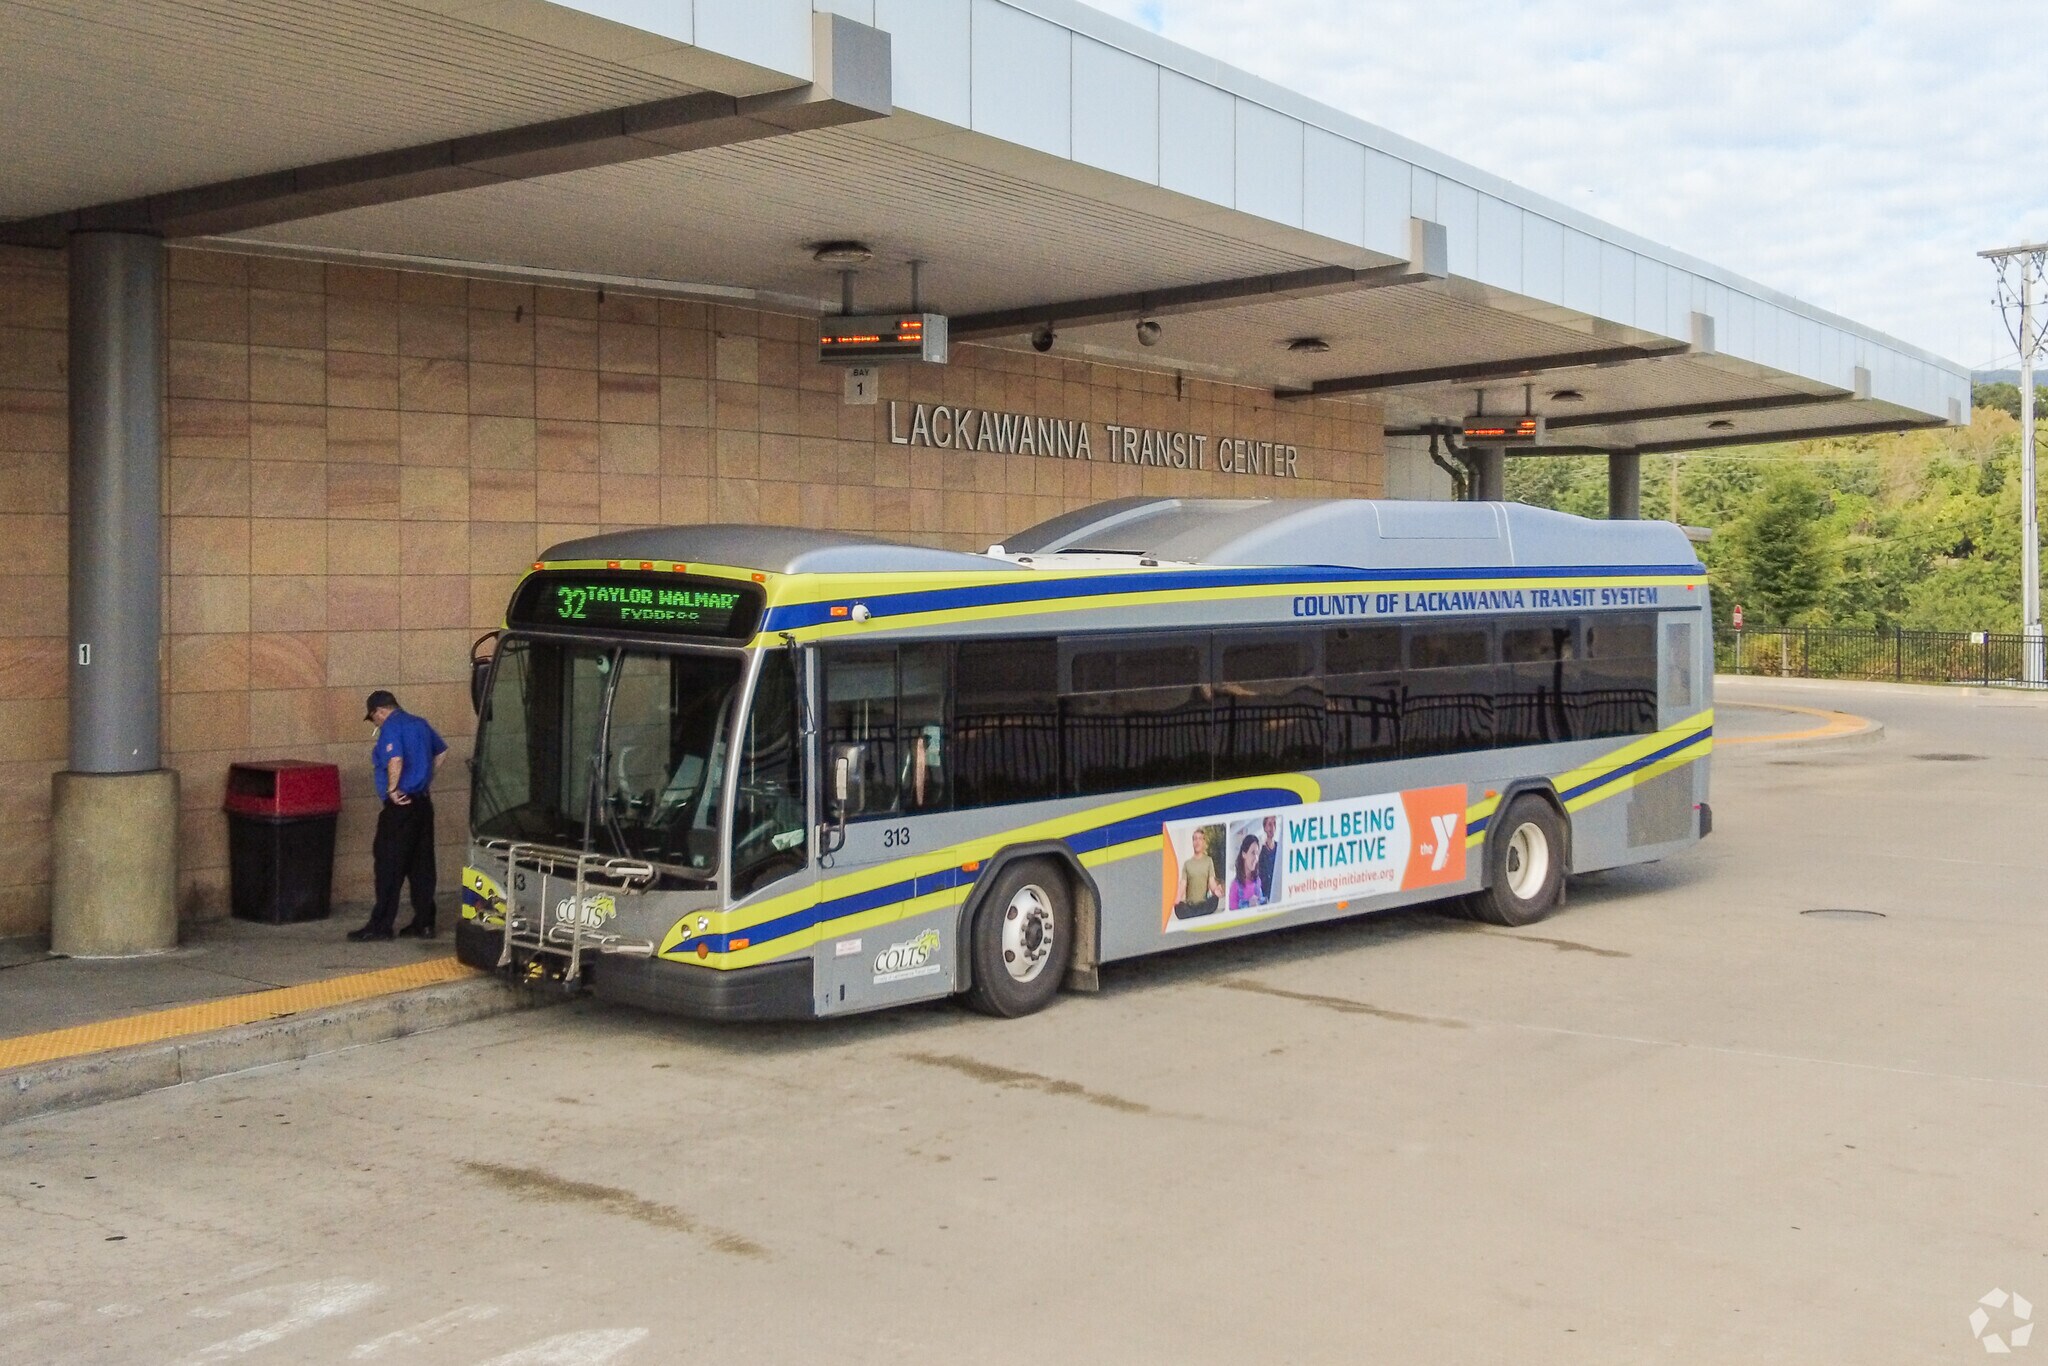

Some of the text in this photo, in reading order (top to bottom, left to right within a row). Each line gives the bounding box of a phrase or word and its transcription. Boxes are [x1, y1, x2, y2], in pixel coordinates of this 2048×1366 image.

[853, 369, 870, 377] BAY
[856, 382, 864, 396] 1
[890, 400, 1299, 478] LACKAWANNA TRANSIT CENTER
[557, 586, 587, 619] 32
[586, 586, 653, 605] TAYLOR
[1293, 587, 1658, 617] COUNTY OF LACKAWANNA TRANSIT SYSTEM
[81, 644, 88, 664] 1
[883, 826, 910, 848] 313
[1288, 806, 1395, 844] WELLBEING
[1288, 836, 1387, 874] INITIATIVE
[1420, 842, 1434, 856] the
[1287, 868, 1395, 896] ywellbeinginitiative.org
[556, 898, 605, 928] COTS
[874, 945, 929, 973] COLTS
